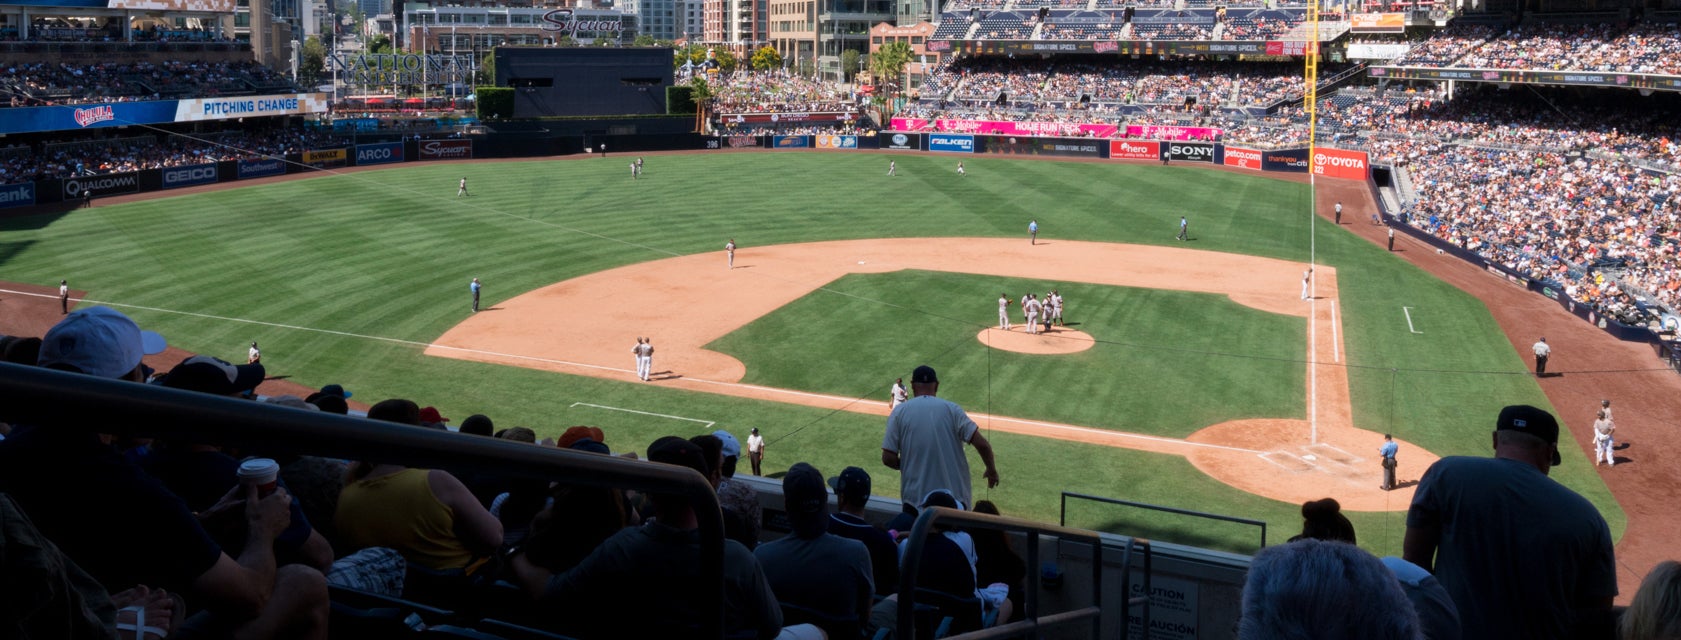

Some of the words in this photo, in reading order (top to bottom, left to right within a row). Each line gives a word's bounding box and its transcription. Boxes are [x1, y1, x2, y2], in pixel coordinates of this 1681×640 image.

[543, 9, 625, 37] Sycuan
[329, 53, 481, 71] NATIONAL
[341, 71, 466, 85] UNIVERSITY
[204, 100, 254, 115] PITCHING
[258, 98, 298, 112] CHANGE
[74, 106, 113, 124] CHOLULA
[1040, 122, 1057, 132] RUN
[706, 140, 719, 149] 396
[931, 138, 972, 146] FALKEN
[358, 147, 391, 160] ARCO
[424, 141, 466, 157] Sycuan
[1127, 145, 1147, 154] hero
[1171, 145, 1213, 157] SONY
[1225, 149, 1260, 161] petco.com
[240, 162, 278, 173] Southwest
[1327, 156, 1364, 169] TOYOTA
[165, 167, 216, 183] GEICO
[1314, 165, 1324, 174] 322
[66, 177, 136, 196] QUALCOMM
